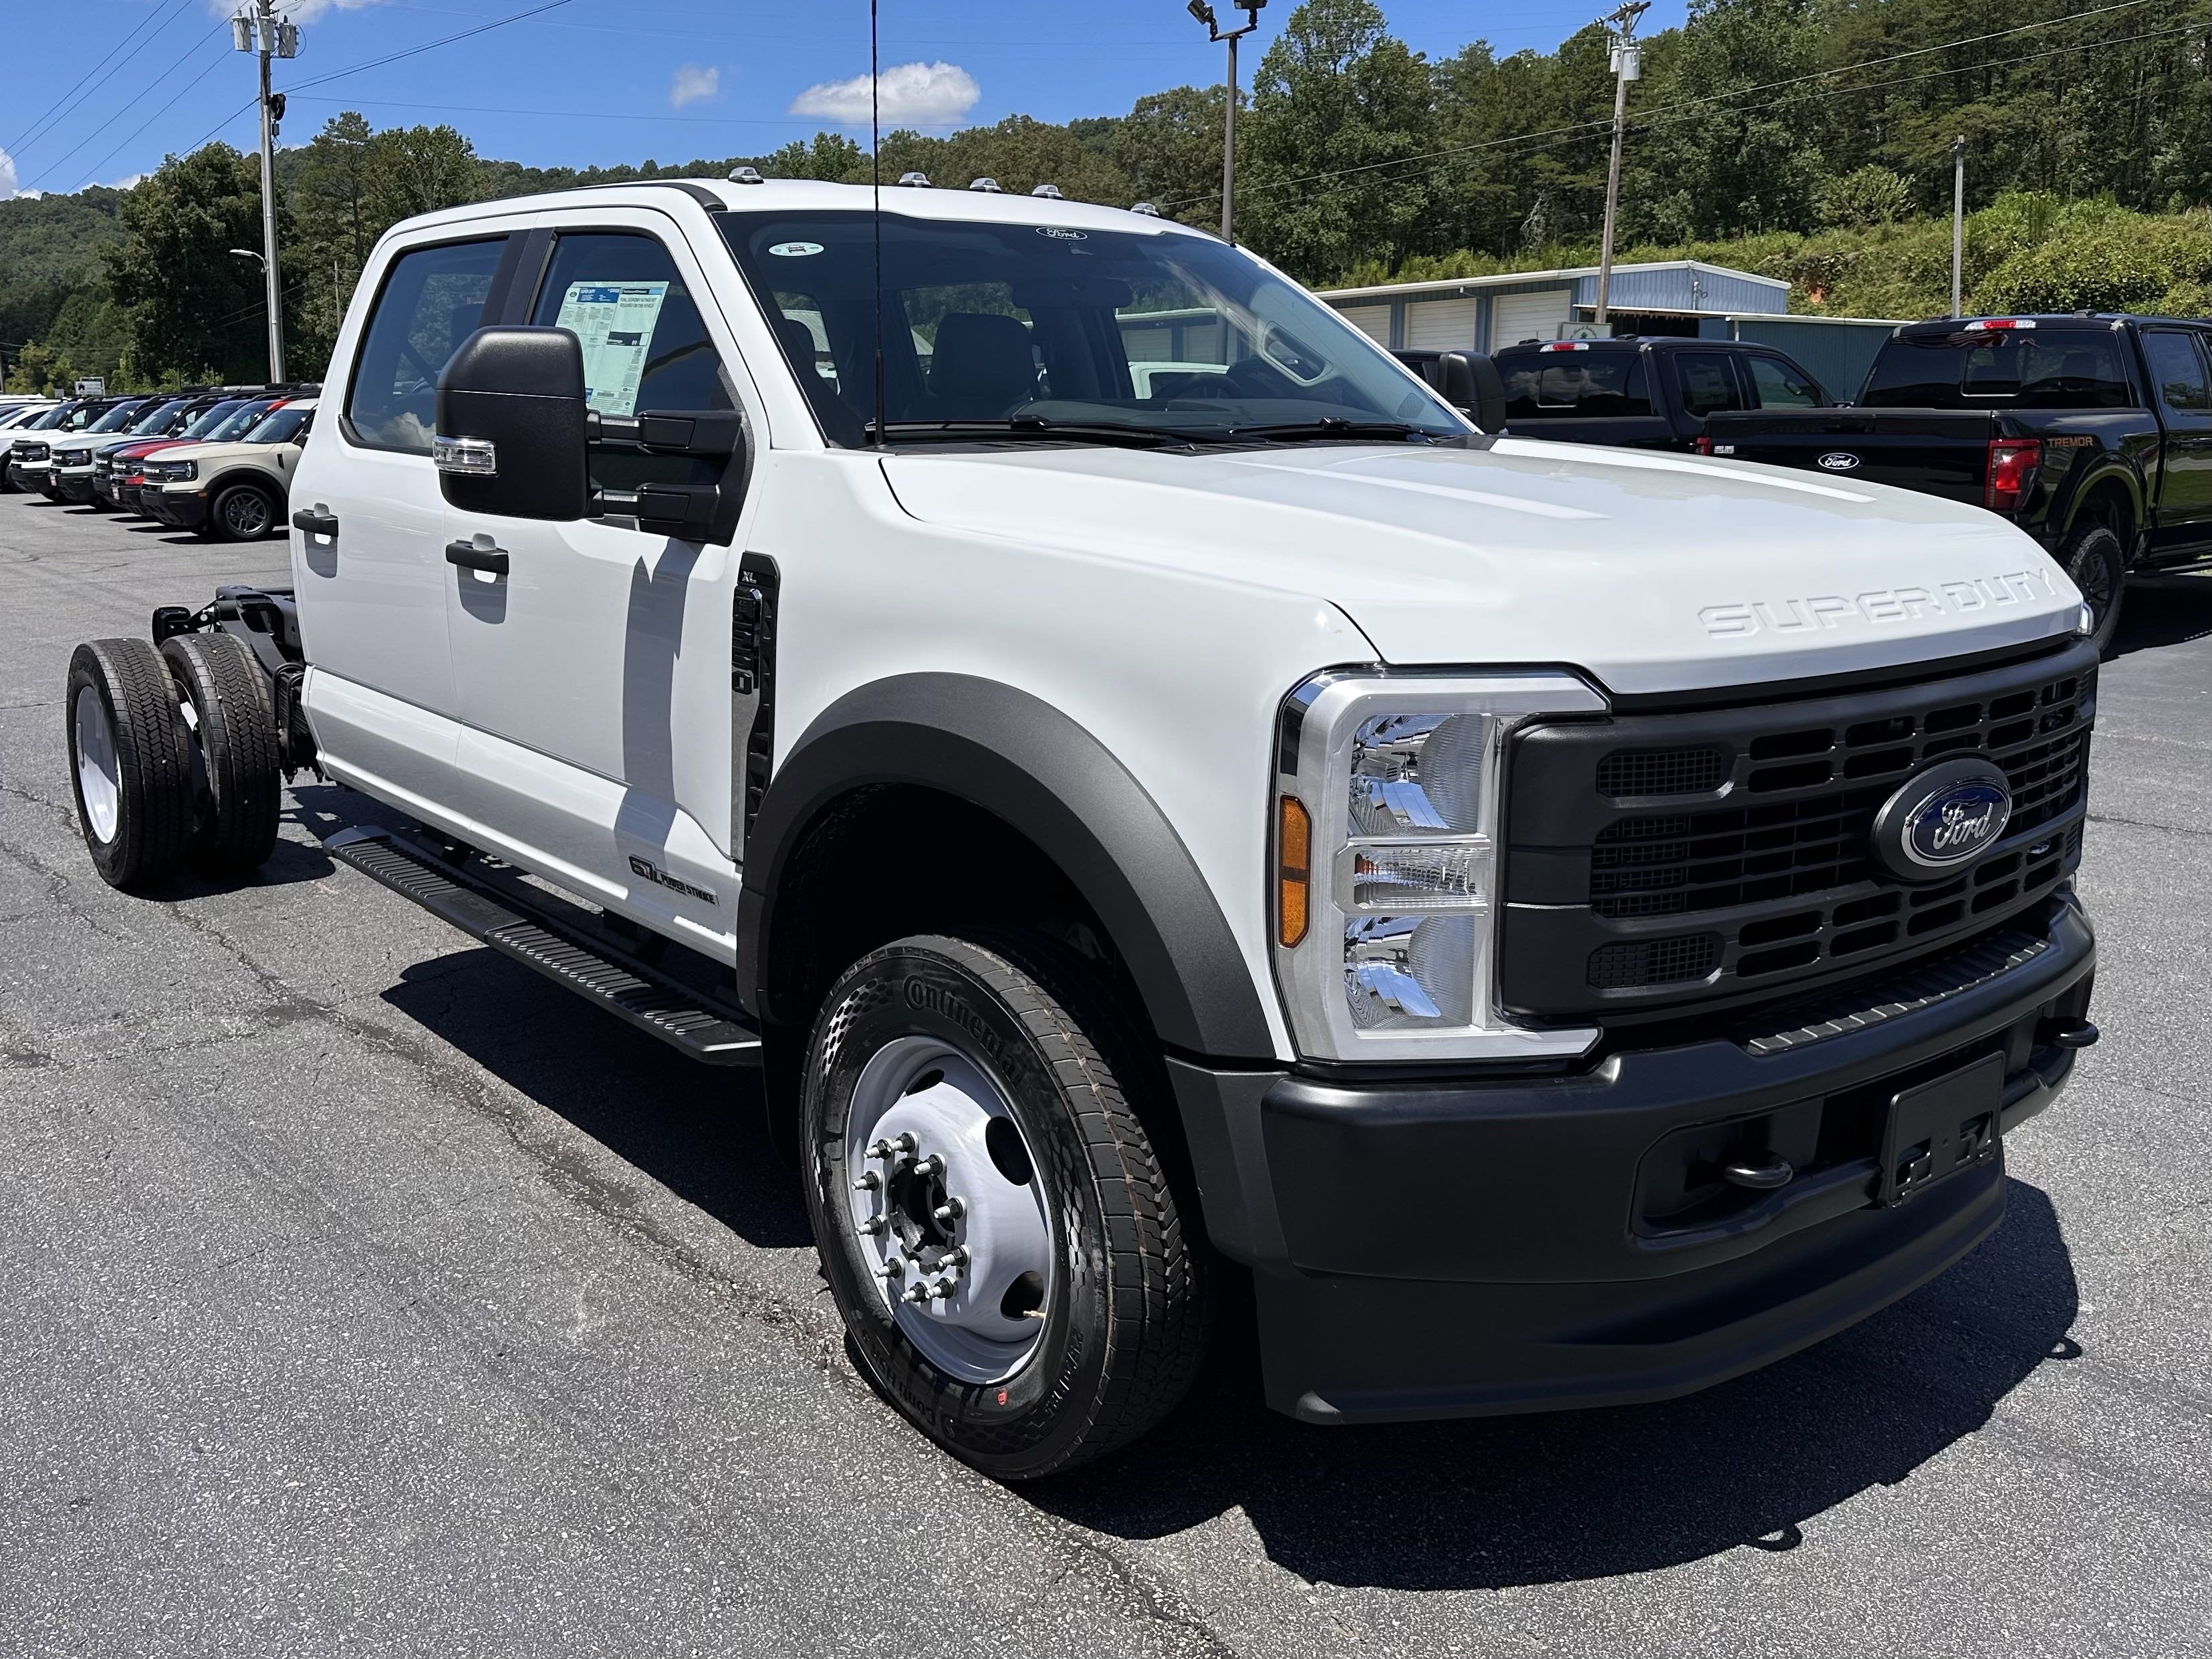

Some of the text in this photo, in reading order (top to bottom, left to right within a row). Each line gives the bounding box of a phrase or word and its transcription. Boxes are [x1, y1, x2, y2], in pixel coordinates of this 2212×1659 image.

[1046, 228, 1080, 239] Ford
[2047, 436, 2094, 448] TREMOR
[1824, 455, 1852, 467] Ford
[741, 570, 757, 584] XL
[1697, 567, 2058, 639] SUPER DUTY
[1932, 794, 1993, 851] Ford
[902, 974, 1027, 1088] Continental
